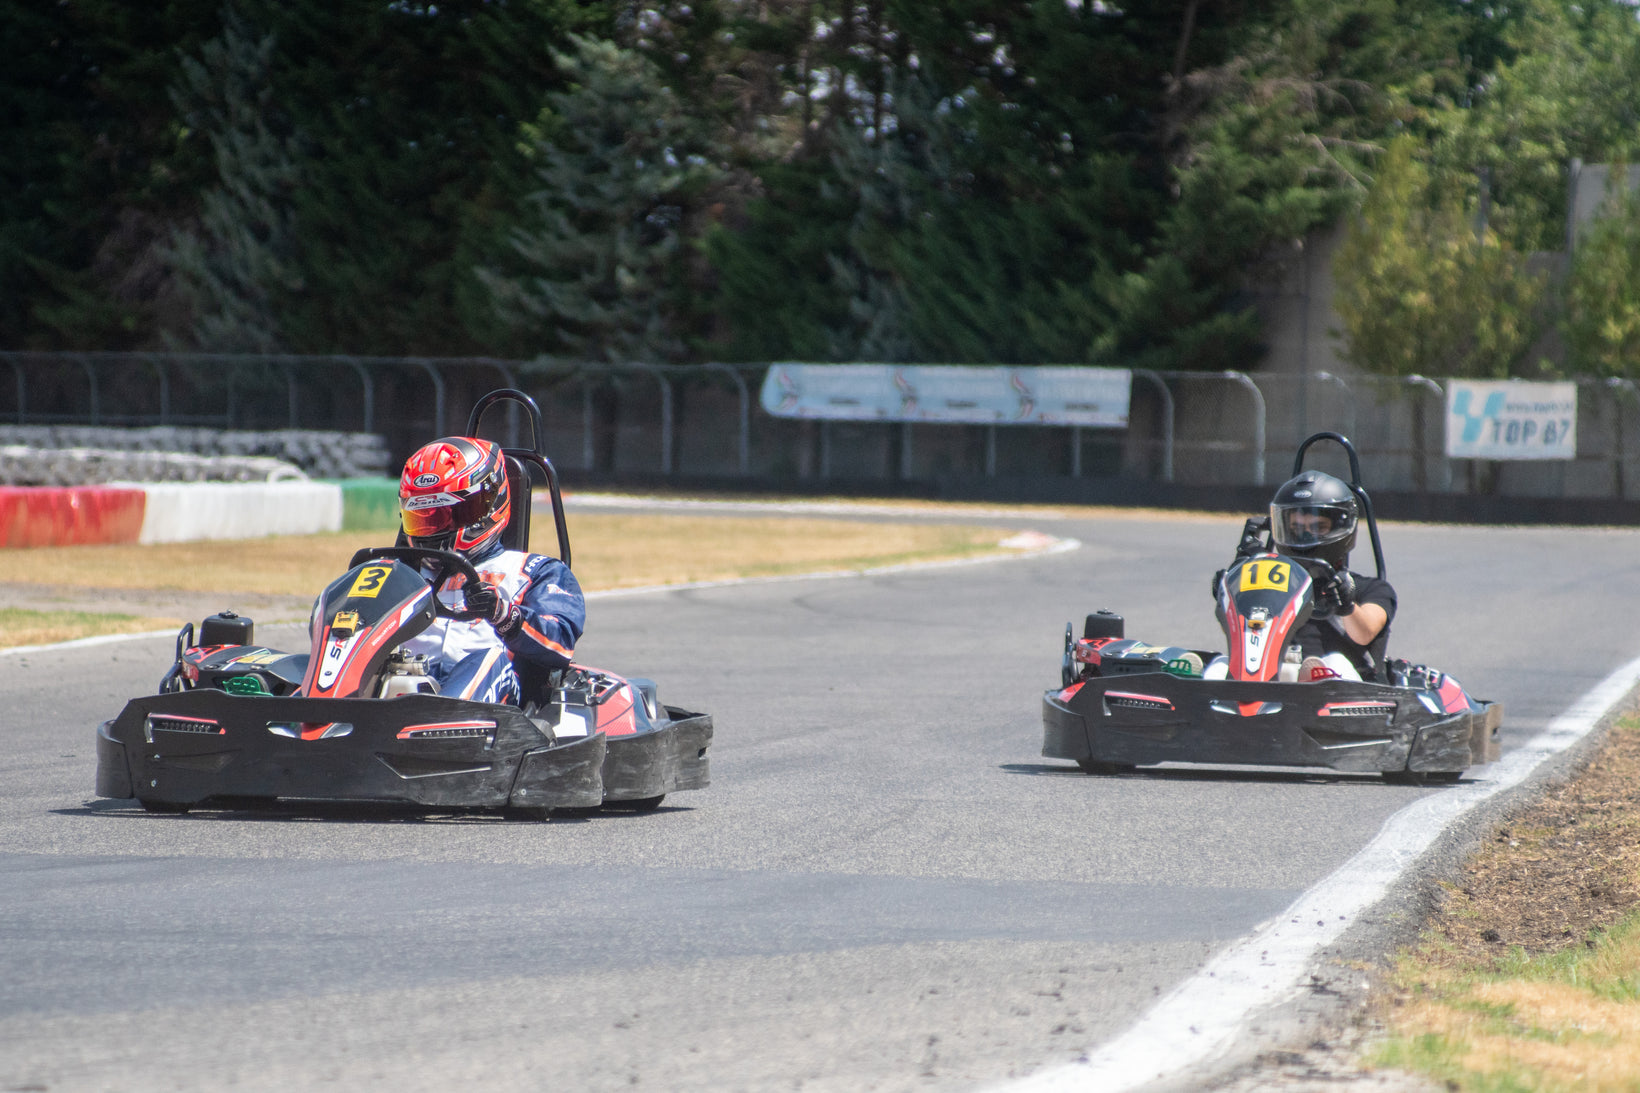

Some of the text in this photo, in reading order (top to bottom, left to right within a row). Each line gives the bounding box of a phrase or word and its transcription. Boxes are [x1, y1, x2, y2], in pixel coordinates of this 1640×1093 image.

[1493, 419, 1537, 445] TOP
[416, 475, 436, 486] Arai
[357, 568, 386, 592] 3
[1248, 564, 1286, 584] 16
